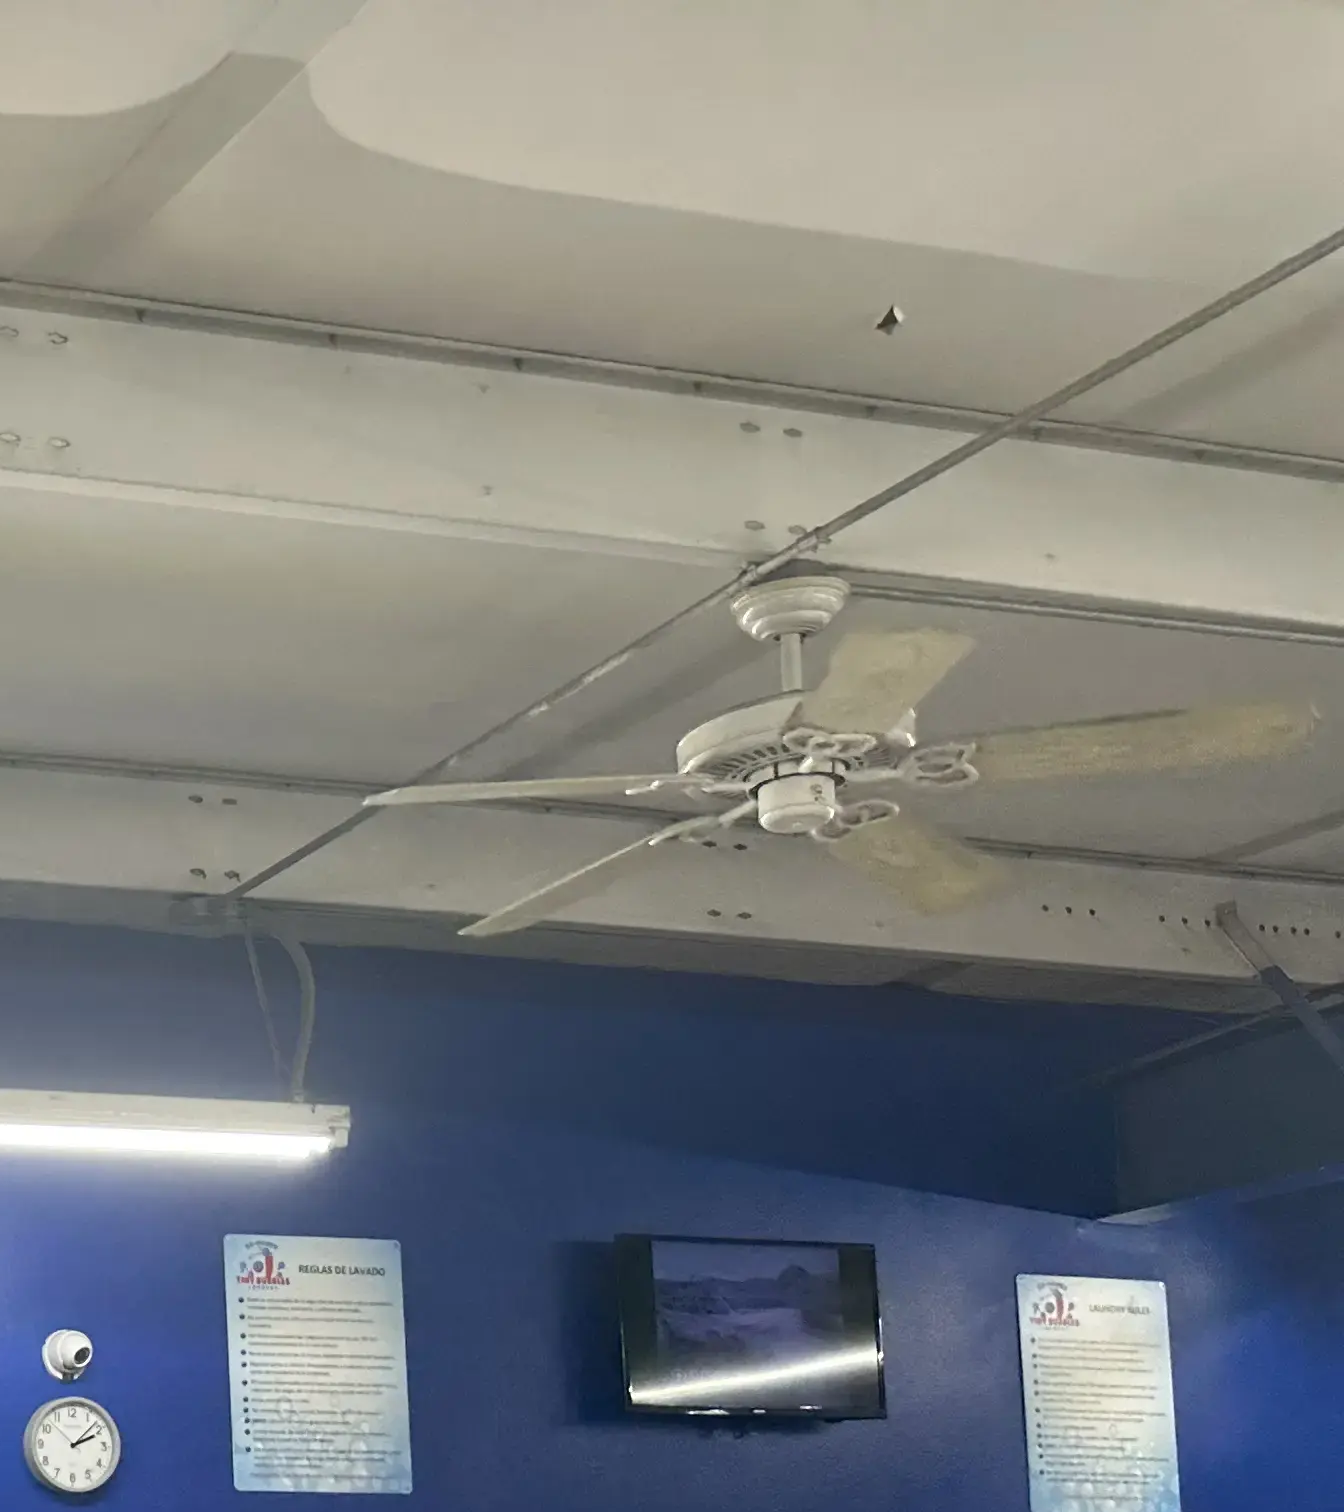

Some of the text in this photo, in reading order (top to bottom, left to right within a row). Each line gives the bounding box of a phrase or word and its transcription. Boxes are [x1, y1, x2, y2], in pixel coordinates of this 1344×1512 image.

[298, 1265, 386, 1277] REGLAS DE LAVADO
